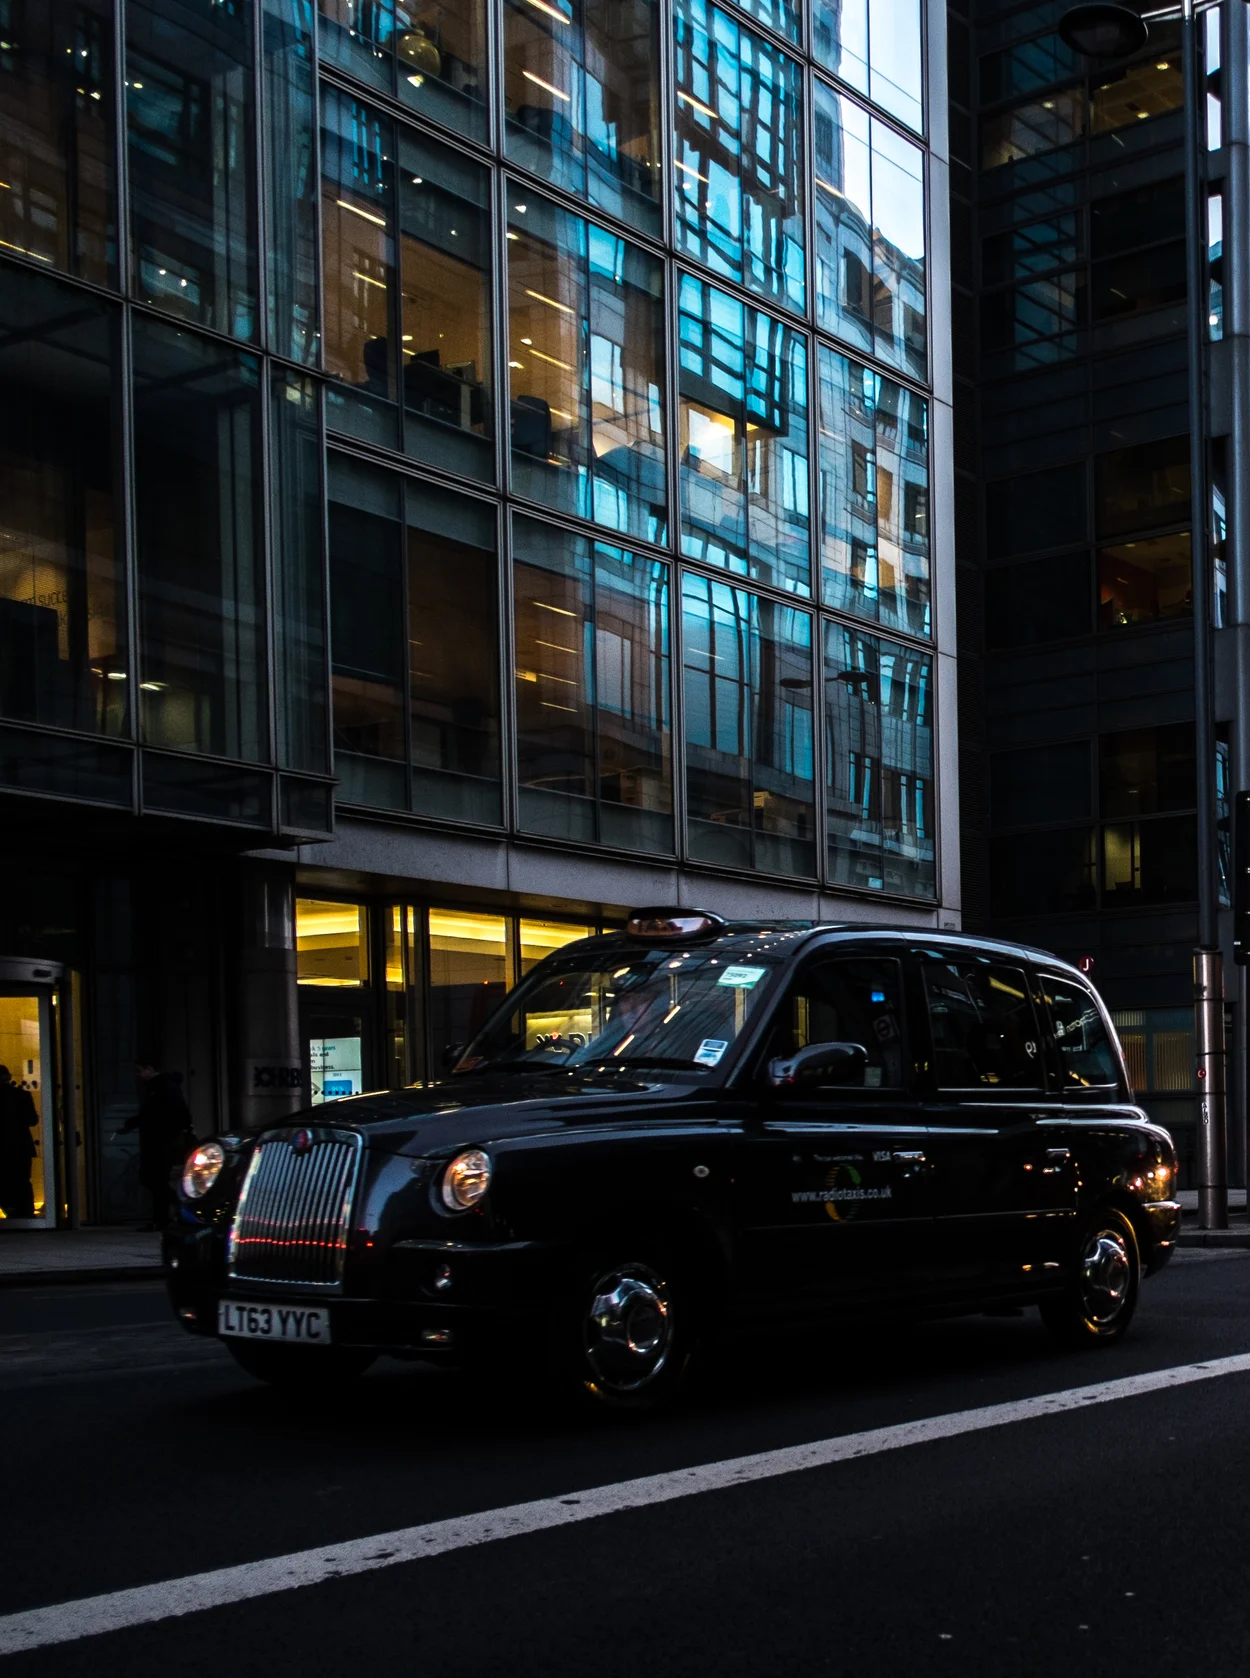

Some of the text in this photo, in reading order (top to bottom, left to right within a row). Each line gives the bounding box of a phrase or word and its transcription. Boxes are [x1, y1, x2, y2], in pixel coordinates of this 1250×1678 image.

[1082, 958, 1090, 972] J
[791, 1184, 893, 1203] www.radiotaxis.co.uk
[224, 1304, 321, 1339] LT63 YYC
